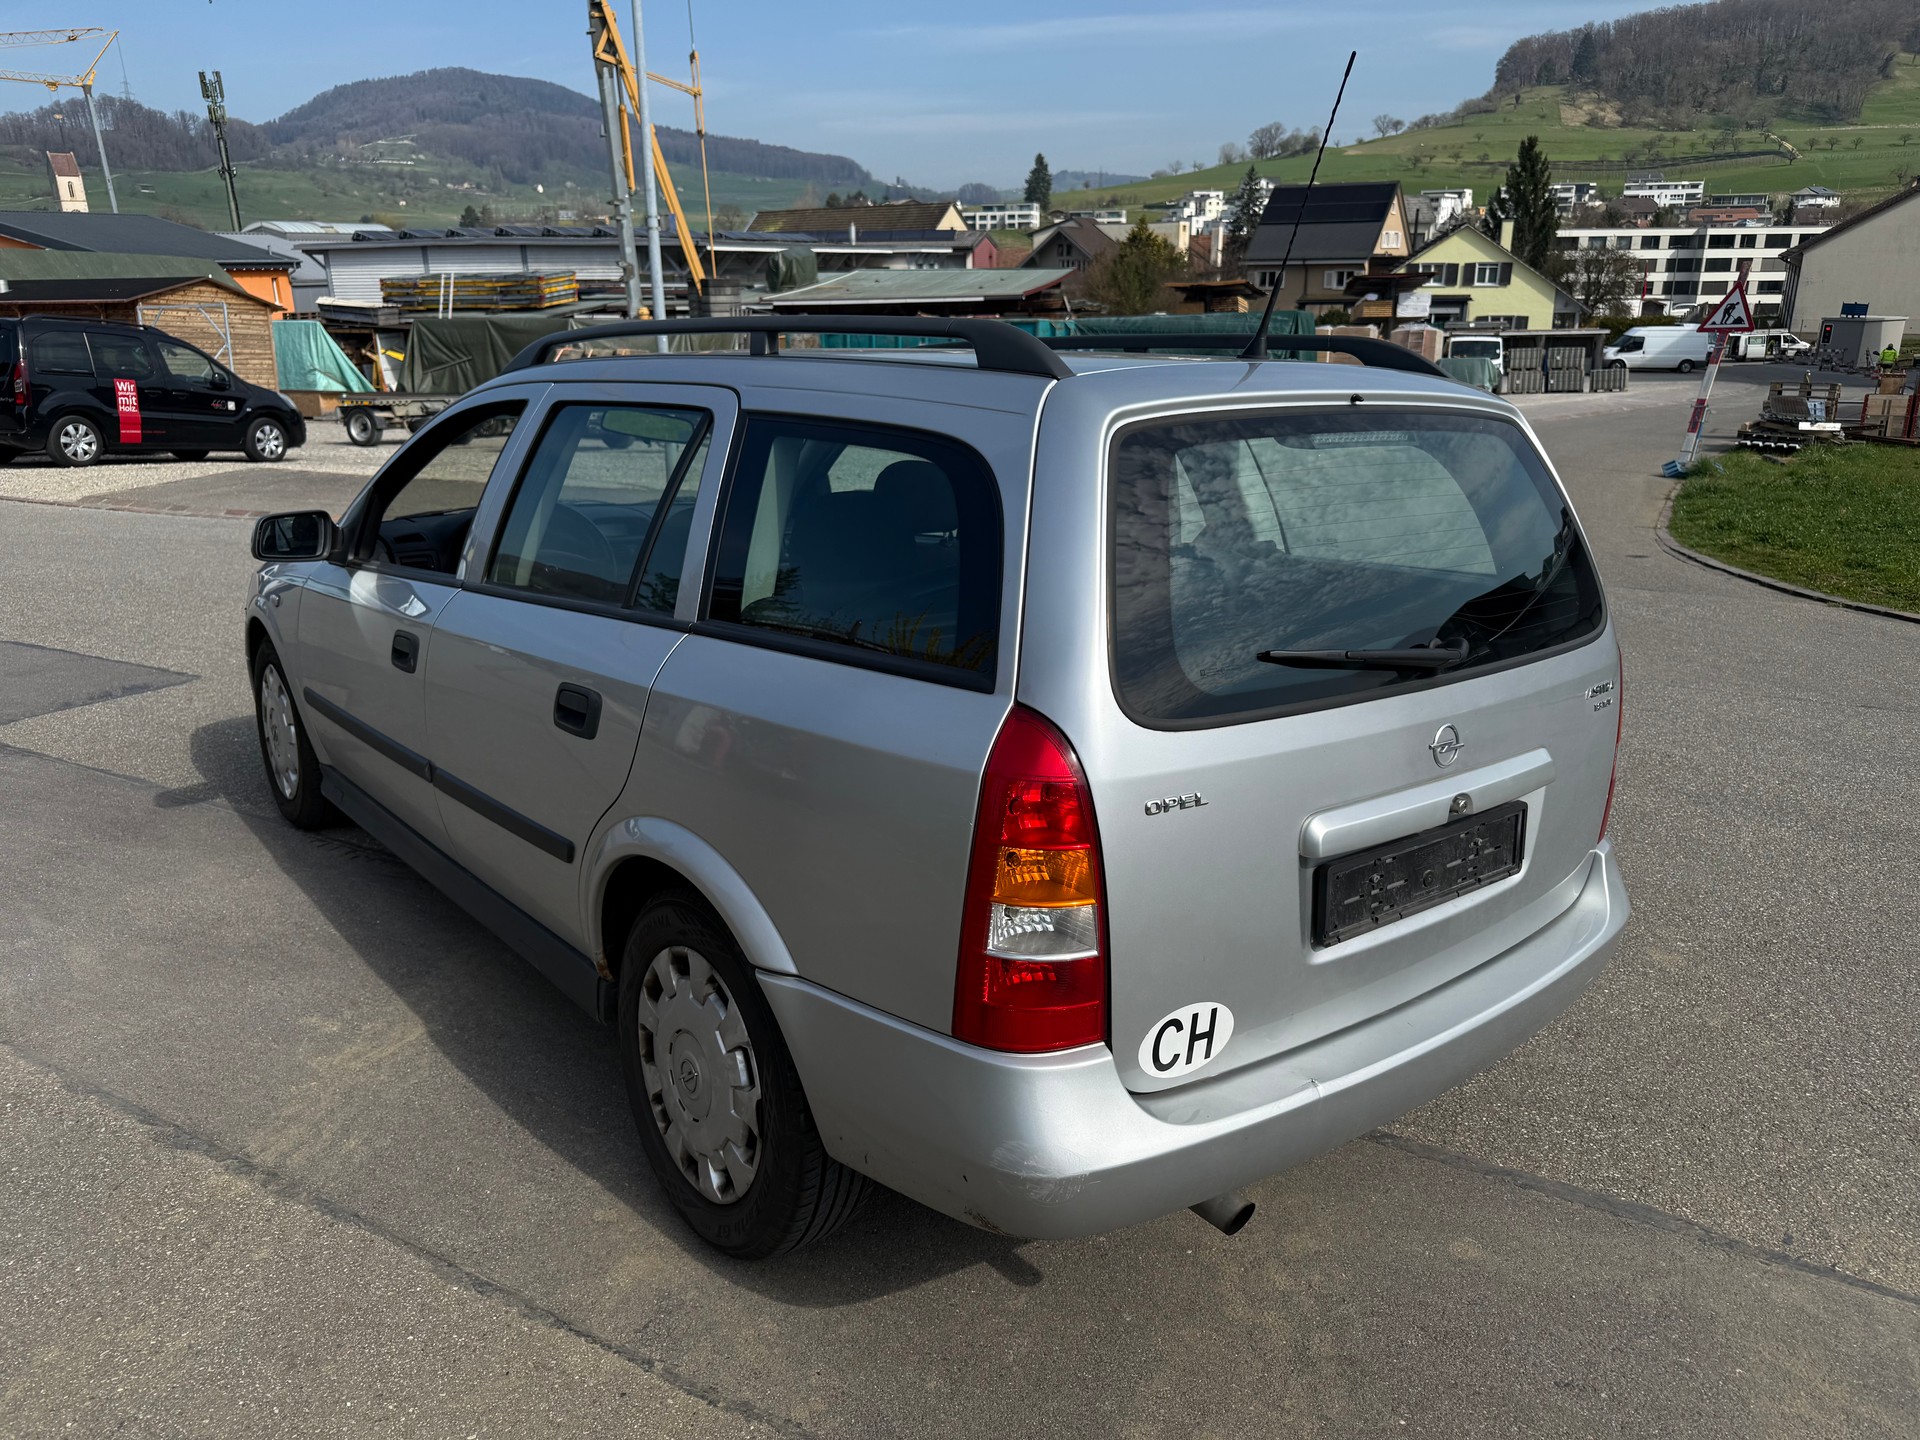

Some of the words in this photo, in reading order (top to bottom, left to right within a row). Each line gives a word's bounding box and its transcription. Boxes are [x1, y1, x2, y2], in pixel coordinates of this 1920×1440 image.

[116, 381, 135, 391] Wir
[118, 395, 137, 405] mit
[119, 404, 138, 412] Holz.
[1144, 792, 1209, 816] OPEL
[1152, 1007, 1218, 1072] CH
